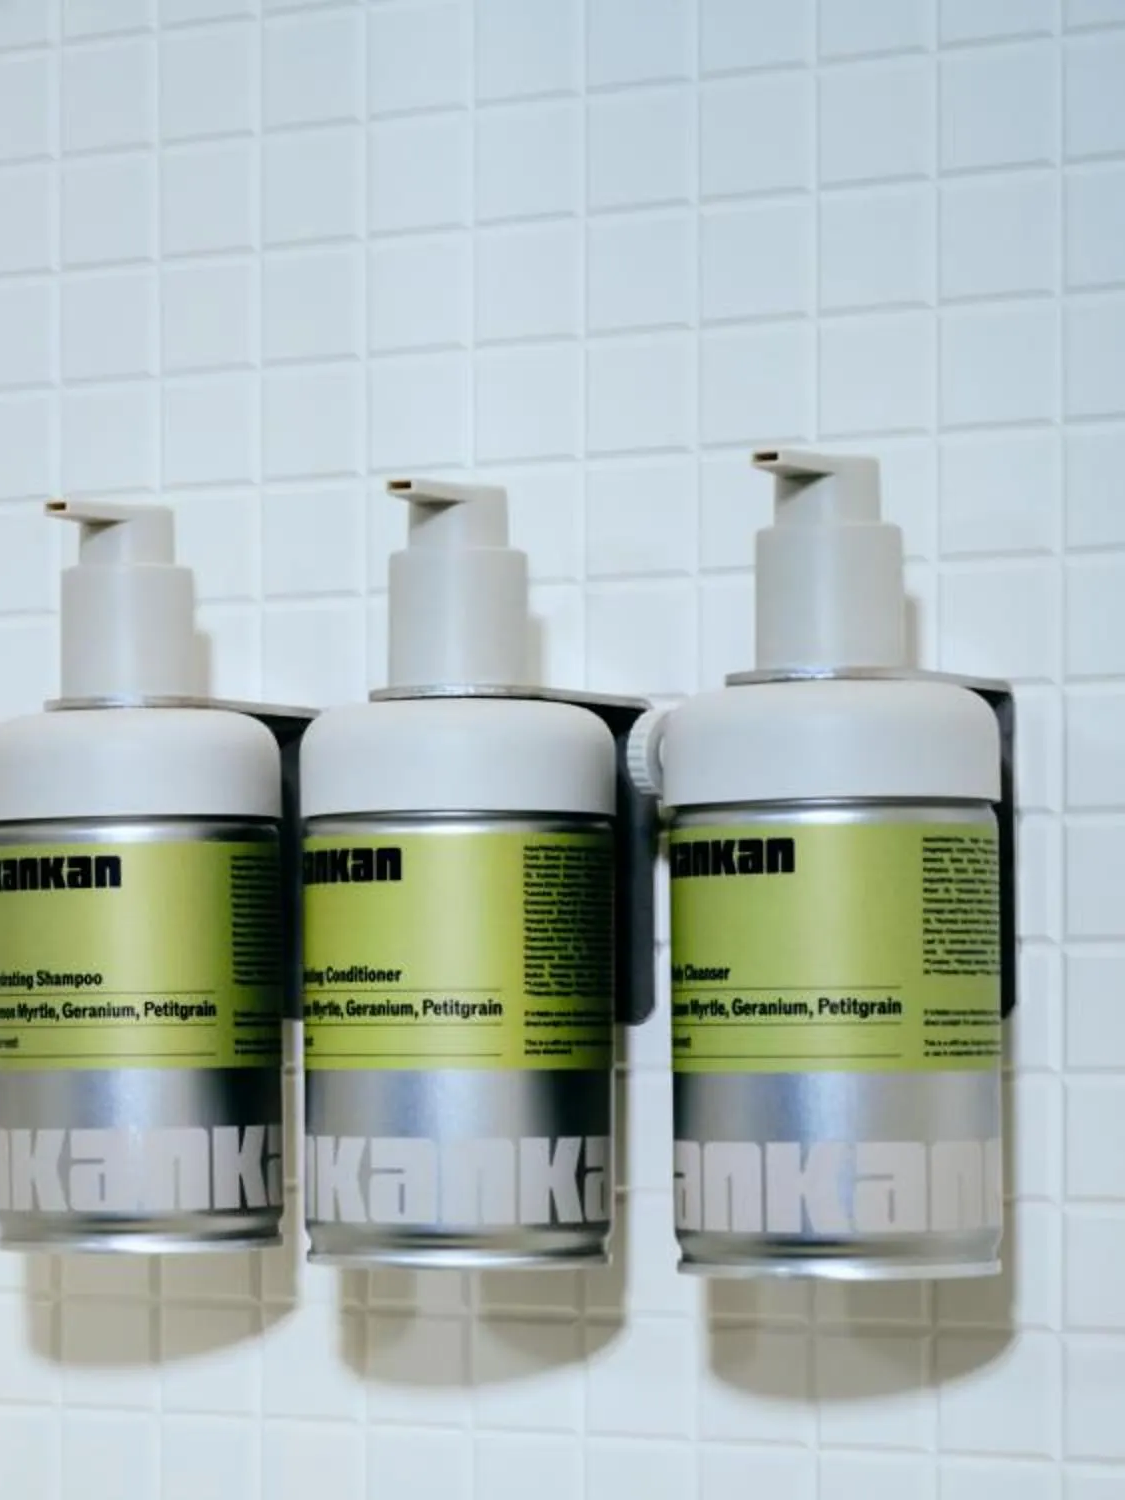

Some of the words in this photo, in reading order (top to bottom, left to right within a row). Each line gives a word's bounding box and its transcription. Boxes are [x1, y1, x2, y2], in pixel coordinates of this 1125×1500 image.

[36, 969, 103, 988] Shampoo
[326, 966, 402, 984] Conditioner
[17, 1001, 59, 1022] Myrtle,
[62, 1000, 140, 1021] Geranium,
[144, 1000, 217, 1020] Petitgrain
[346, 998, 419, 1020] Geranium,
[422, 998, 503, 1019] Petitgrain
[690, 998, 729, 1020] Myrtle,
[732, 996, 813, 1019] Geranium,
[818, 997, 902, 1018] Petitgrain
